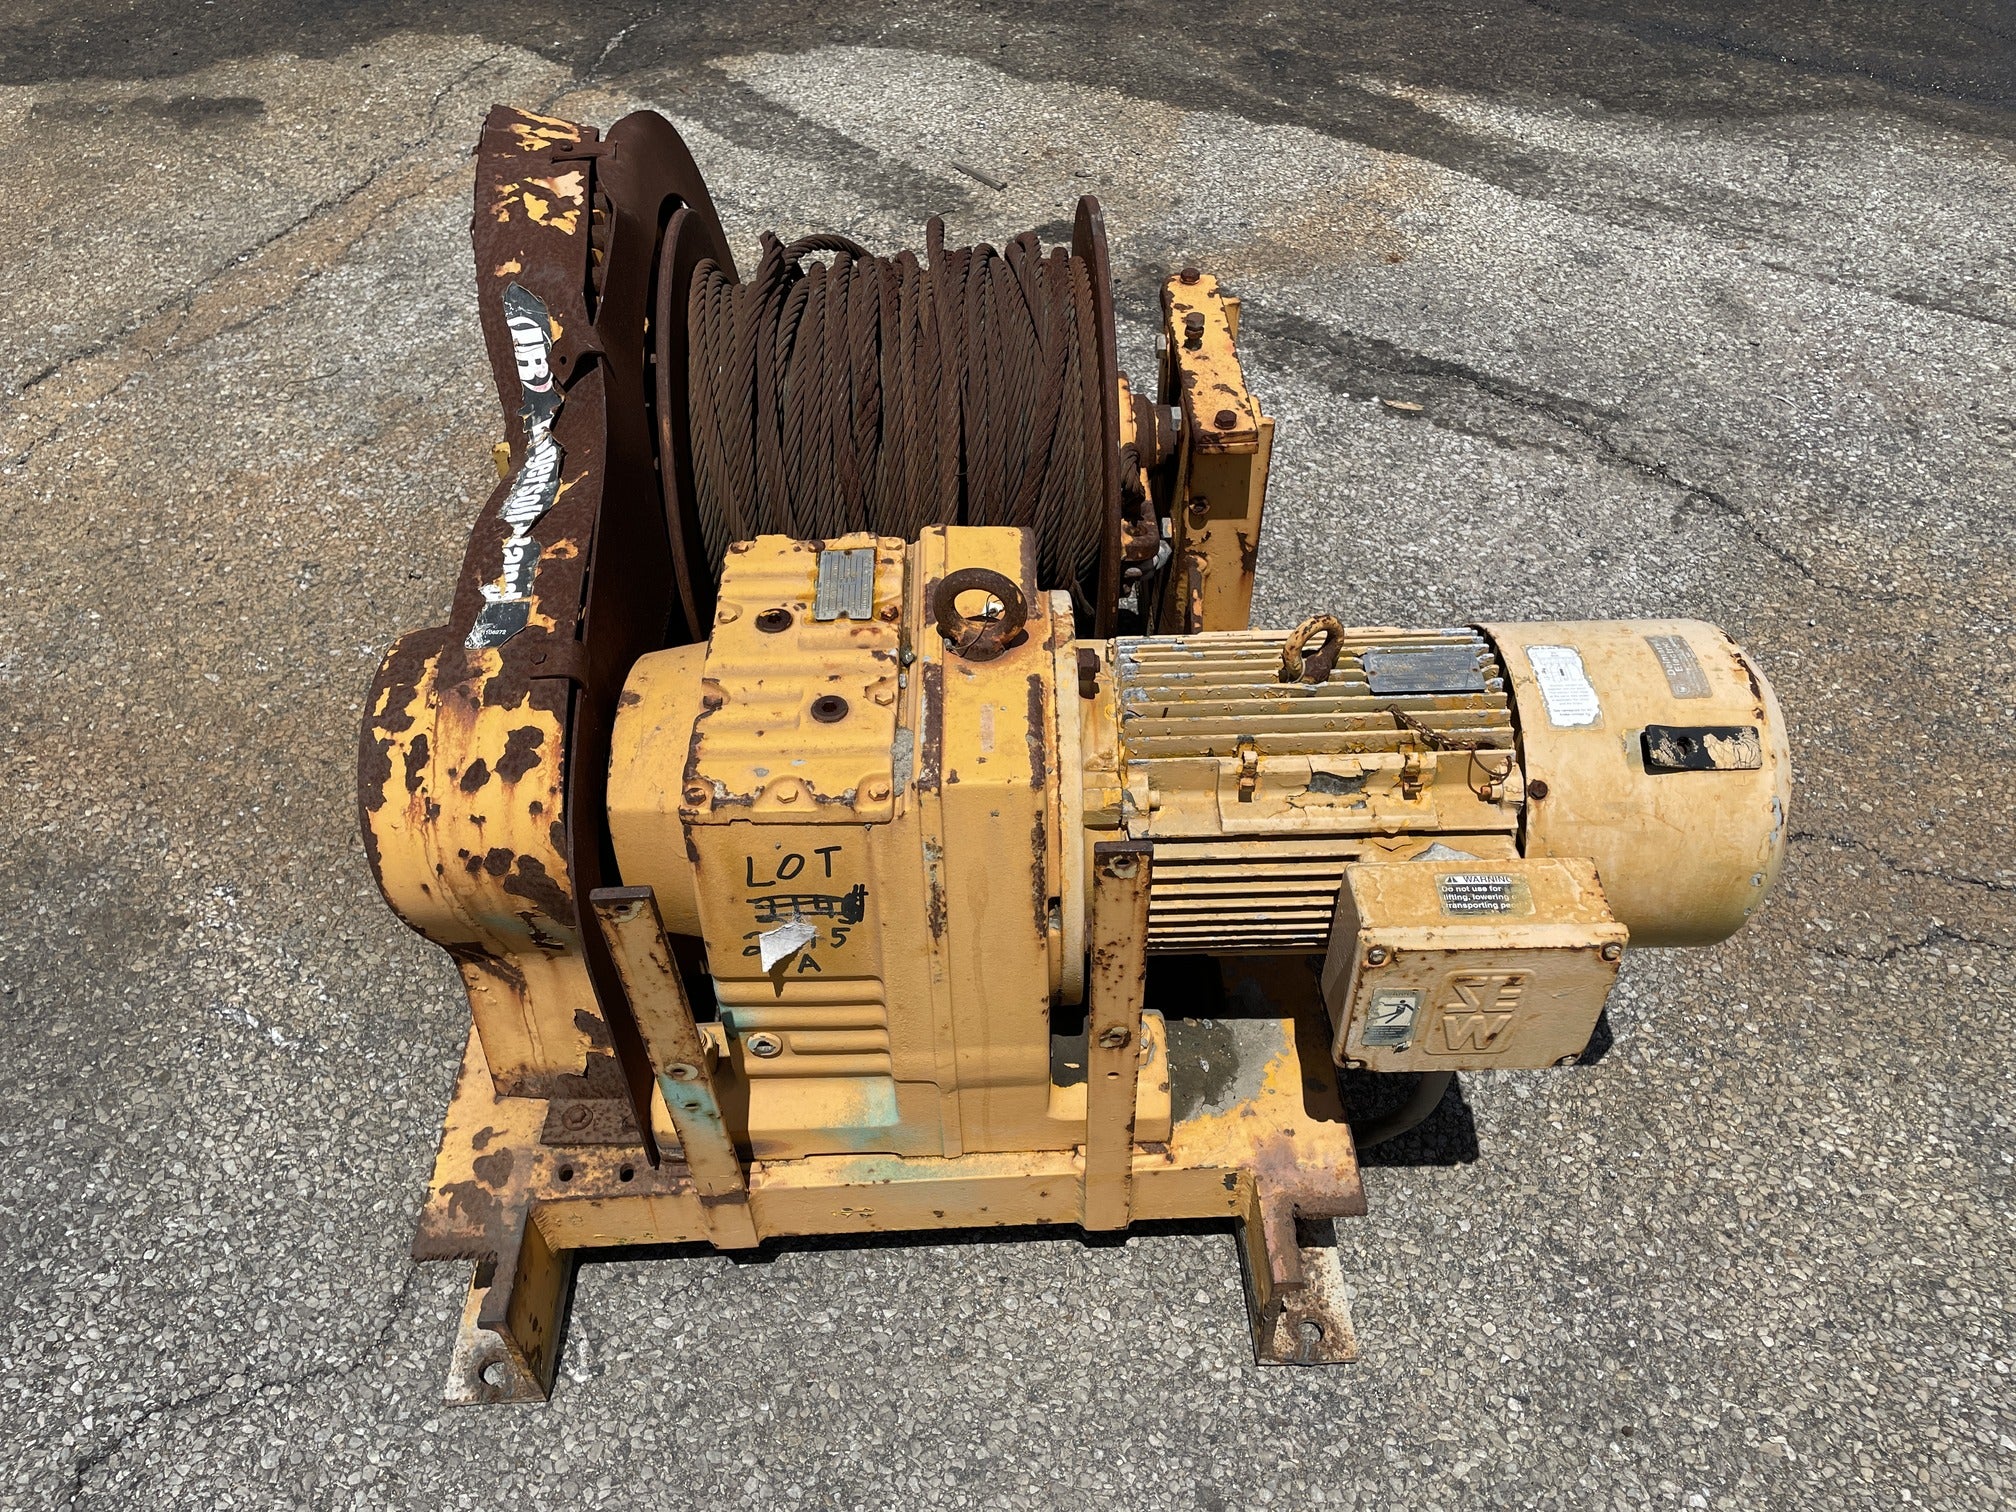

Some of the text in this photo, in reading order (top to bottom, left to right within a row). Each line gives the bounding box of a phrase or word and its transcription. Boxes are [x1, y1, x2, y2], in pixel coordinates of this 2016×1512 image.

[746, 845, 842, 887] LOT
[1472, 893, 1509, 902] lowering
[797, 953, 822, 973] A
